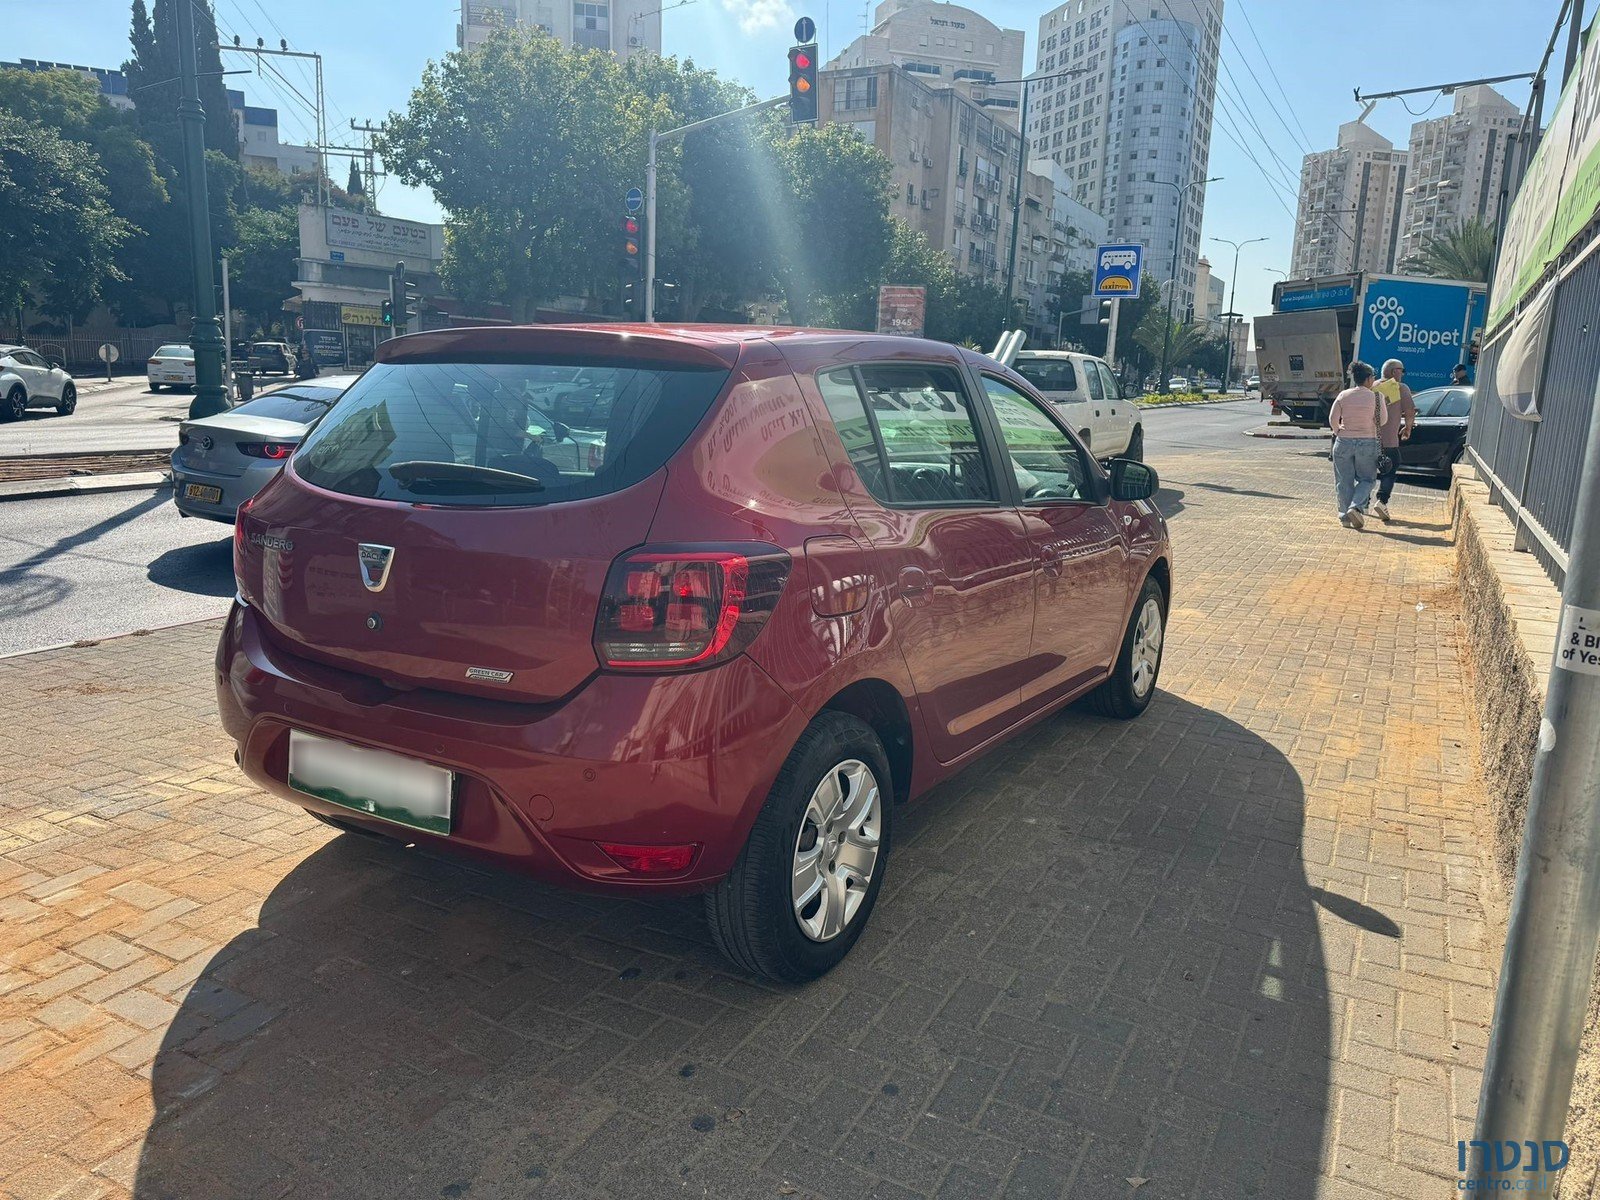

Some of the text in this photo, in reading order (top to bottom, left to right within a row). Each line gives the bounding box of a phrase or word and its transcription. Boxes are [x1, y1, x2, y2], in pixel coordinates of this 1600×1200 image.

[331, 214, 359, 229] פעם
[366, 217, 386, 232] של
[392, 225, 426, 240] בטעם
[1398, 323, 1460, 349] Biopet
[251, 533, 293, 551] SANDERO
[361, 551, 387, 561] DACIA
[1570, 632, 1579, 645] &
[1562, 648, 1575, 660] of
